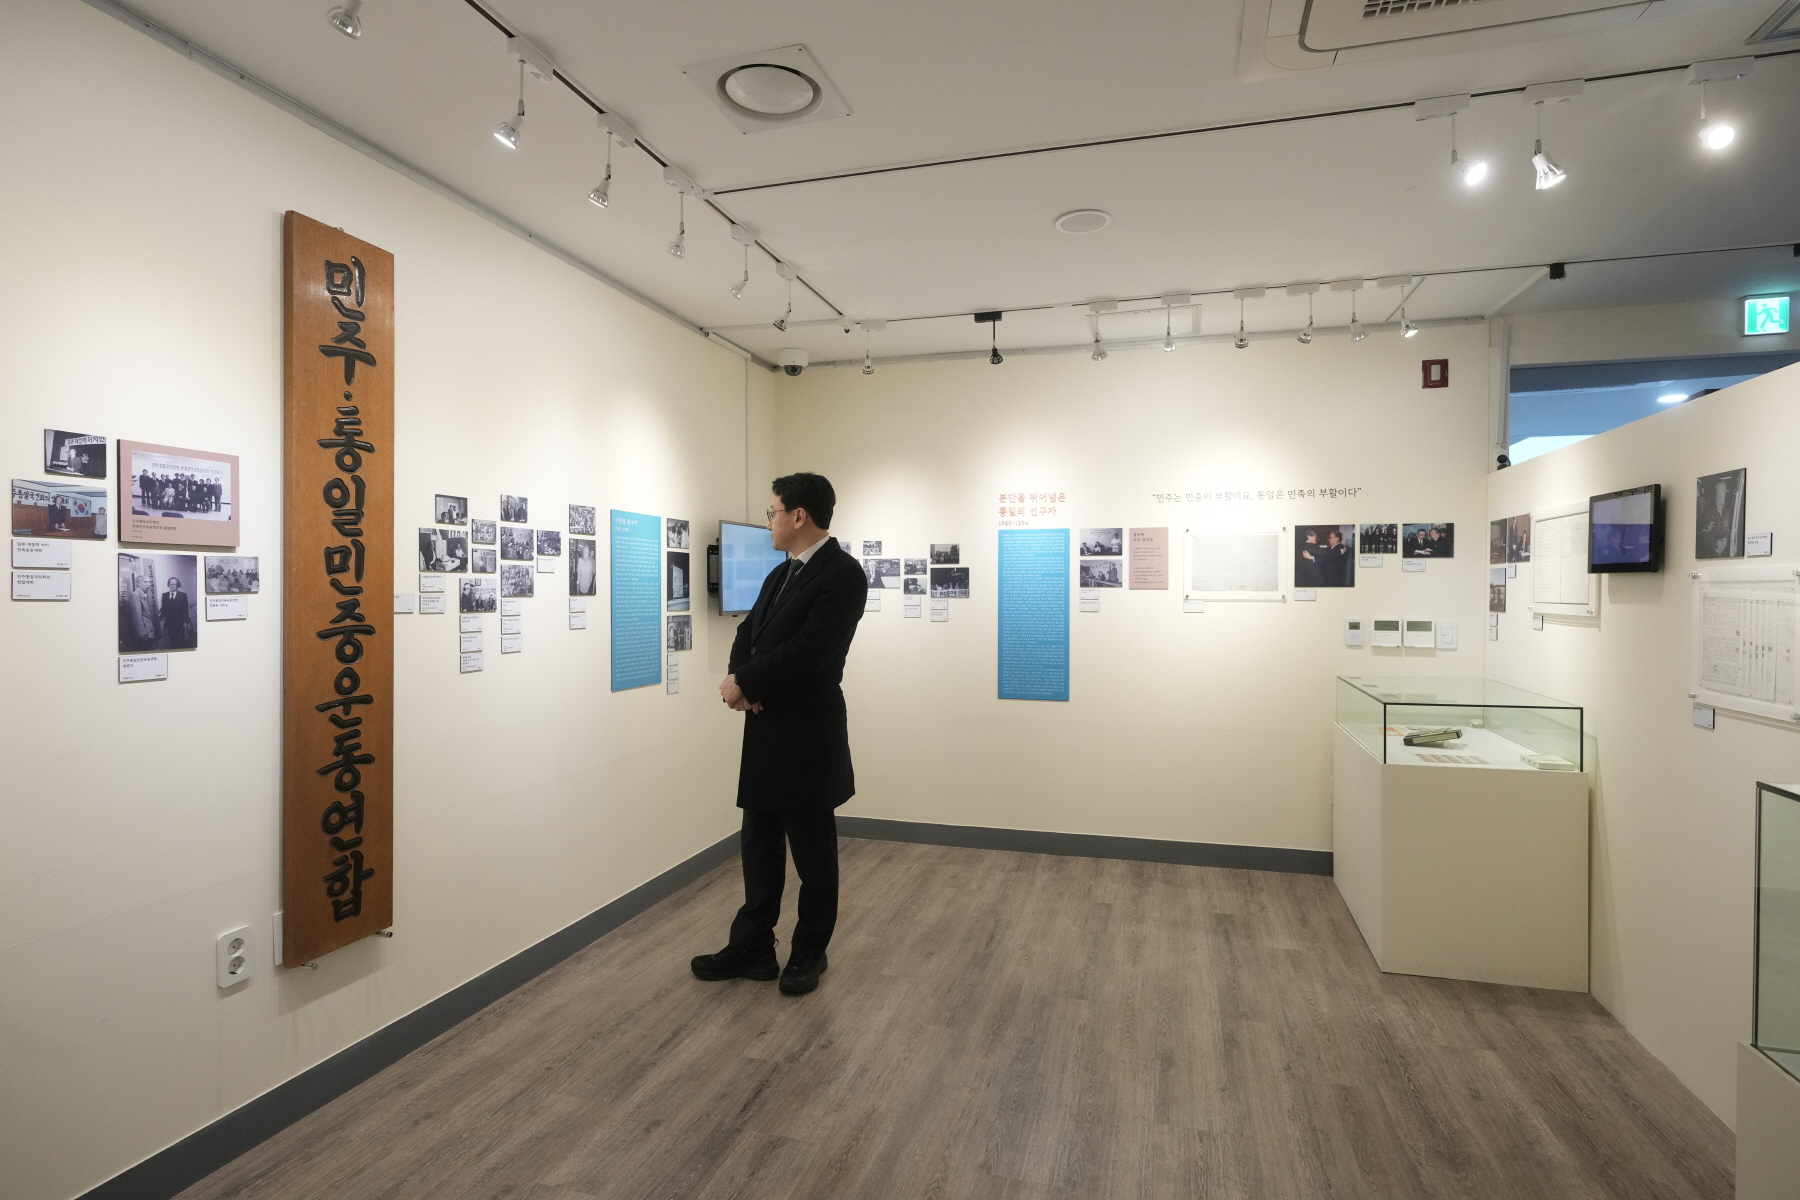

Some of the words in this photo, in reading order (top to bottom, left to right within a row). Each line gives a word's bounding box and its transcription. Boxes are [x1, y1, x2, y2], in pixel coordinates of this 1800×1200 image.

[998, 492, 1026, 504] 분단을
[1029, 492, 1067, 503] 뛰어넘은
[1185, 492, 1211, 503] 민중의
[1215, 491, 1254, 502] 부활이요,
[1257, 489, 1284, 501] 통일은
[1287, 488, 1315, 500] 민족의
[998, 506, 1025, 517] 통일의
[1029, 506, 1057, 517] 선구자
[315, 255, 377, 923] 민주·통일민중운동연합
